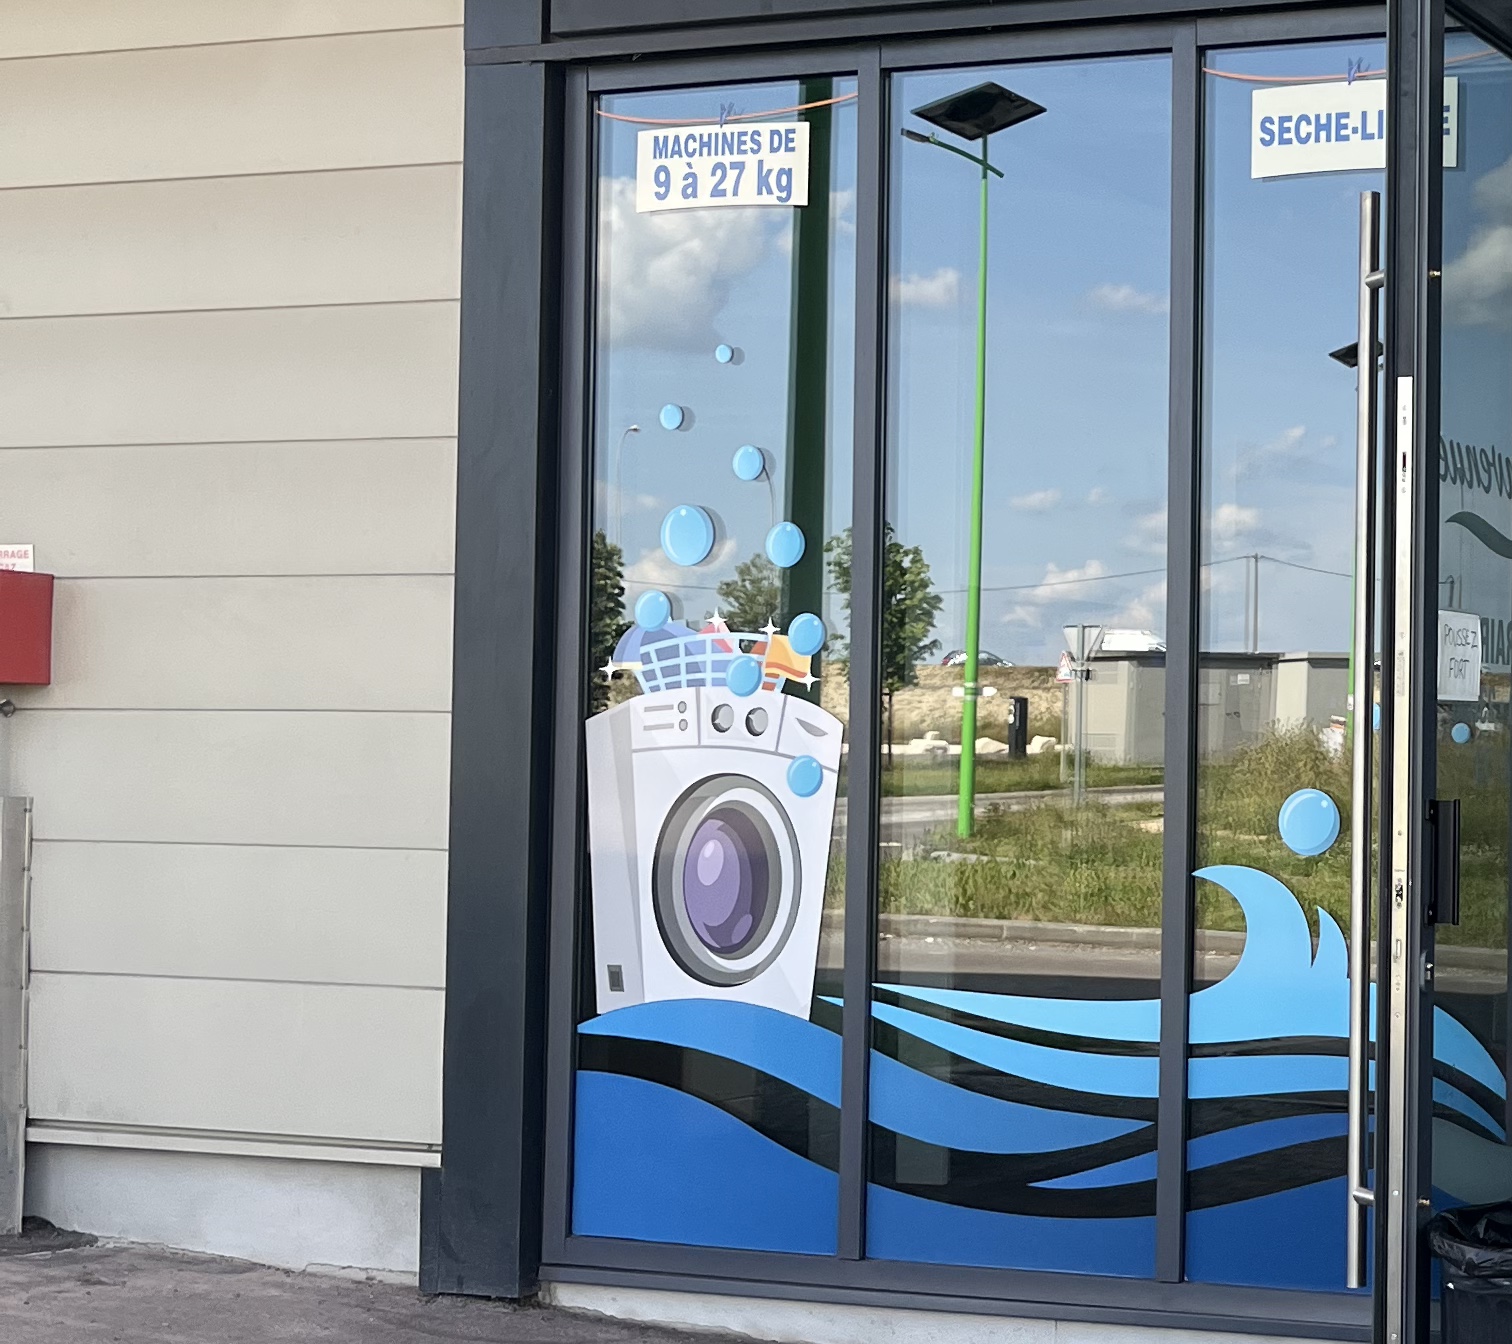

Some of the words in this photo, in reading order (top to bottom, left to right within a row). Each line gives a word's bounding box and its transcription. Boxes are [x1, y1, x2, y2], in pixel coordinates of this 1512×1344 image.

[1260, 105, 1450, 147] SECHE-LIE
[653, 129, 762, 160] MACHINES
[769, 128, 796, 154] DE
[654, 164, 671, 201] 9
[681, 161, 698, 200] à
[709, 160, 746, 198] 27
[756, 159, 793, 203] kg
[1443, 623, 1478, 648] POUSSEZ
[1448, 657, 1470, 680] FORT
